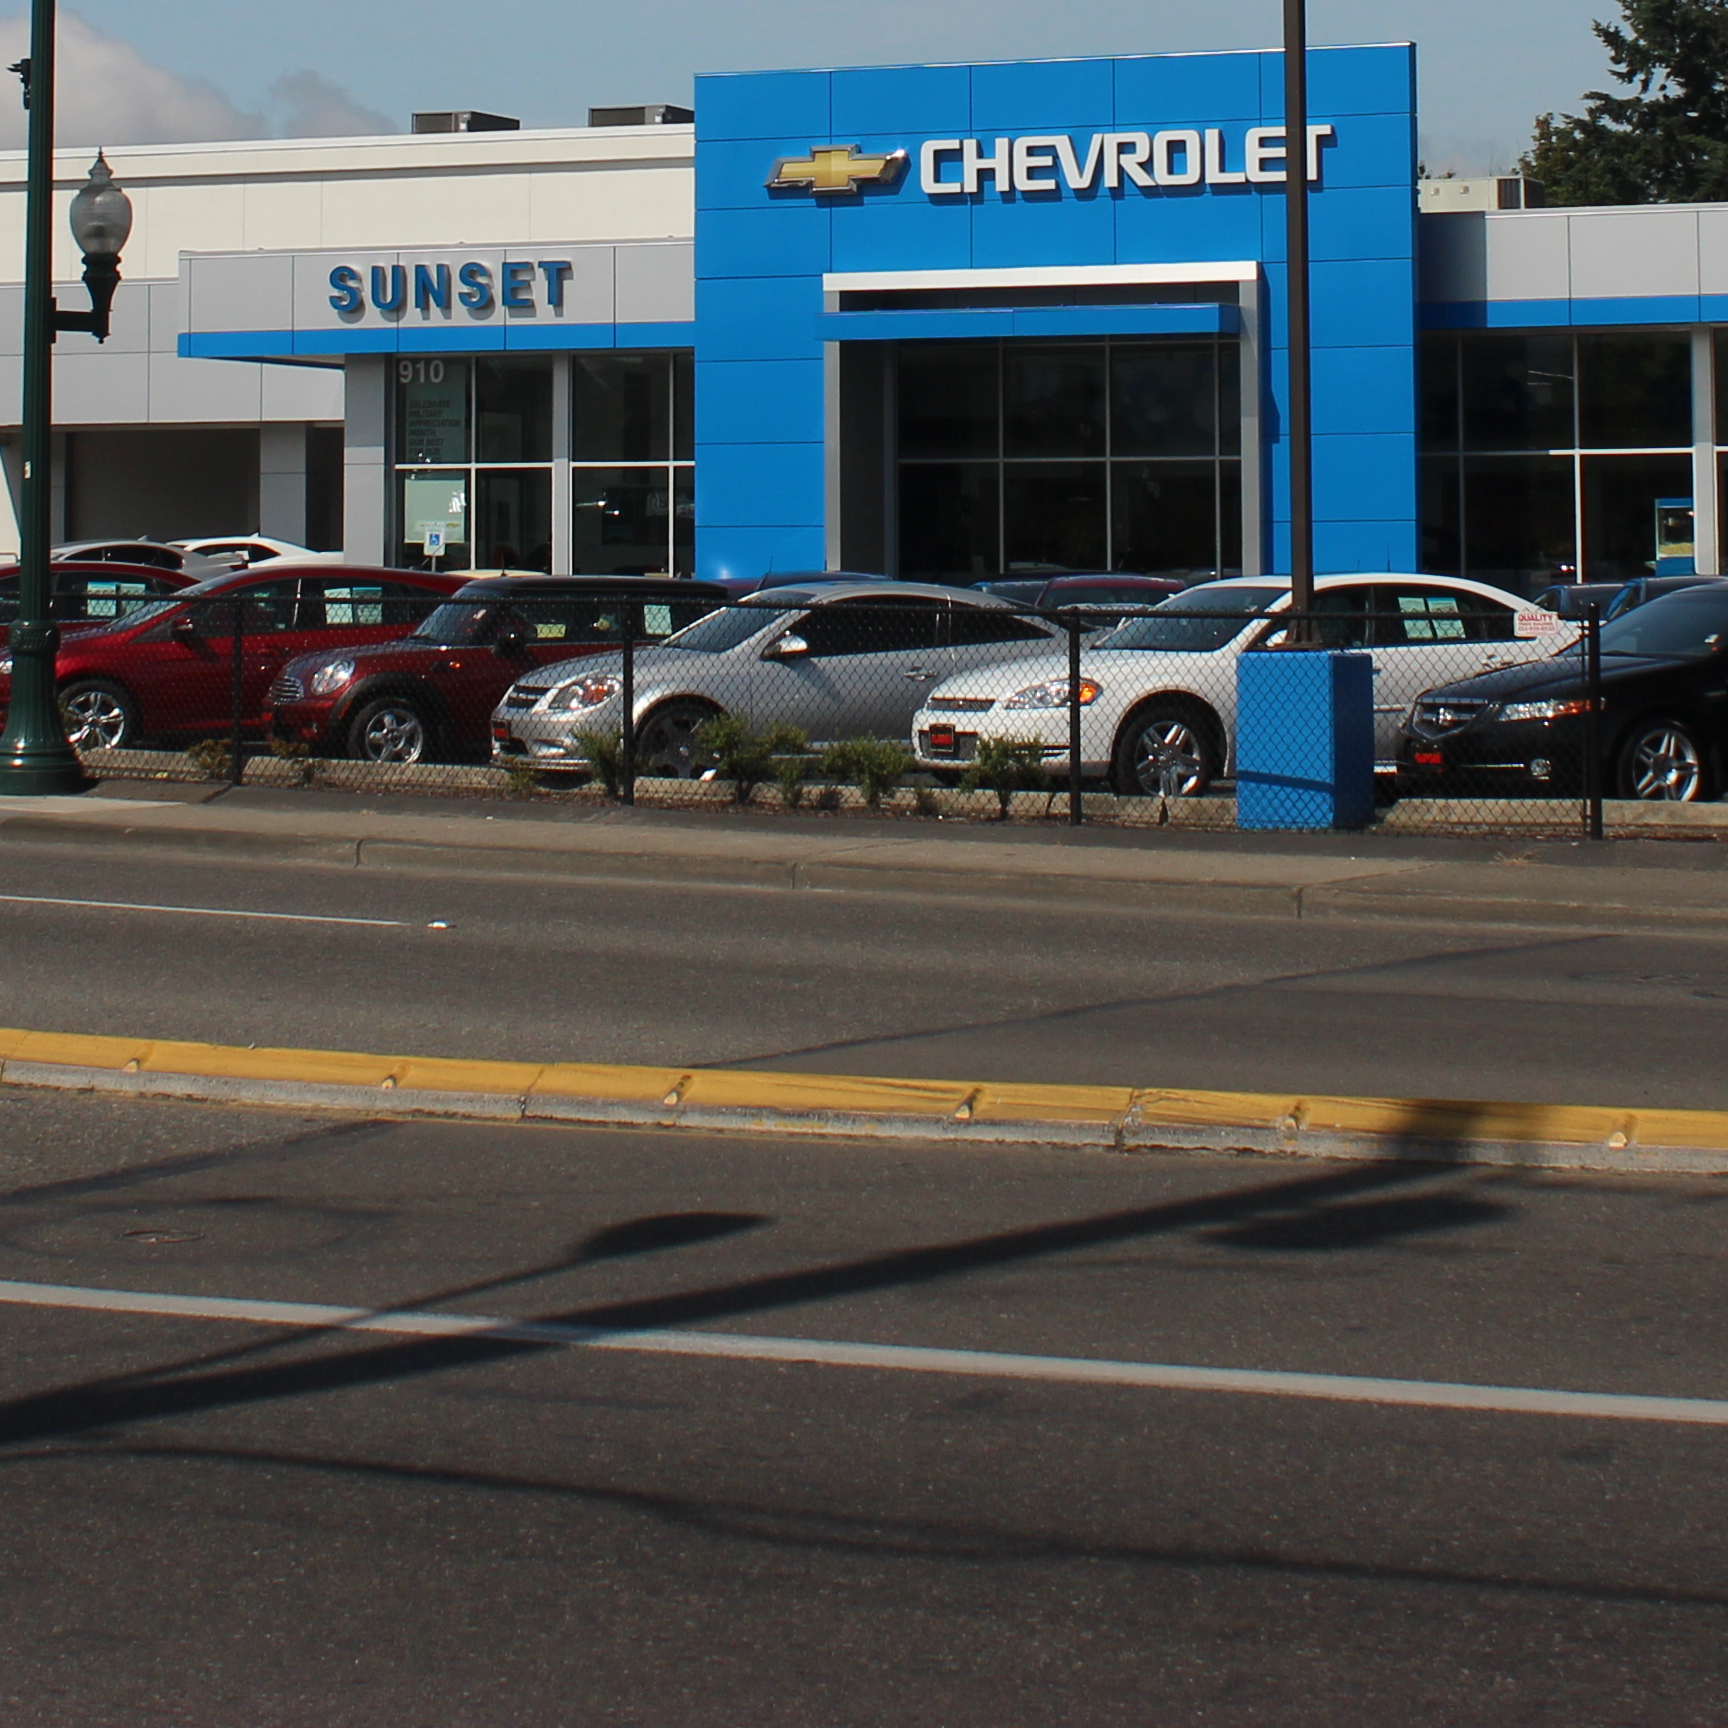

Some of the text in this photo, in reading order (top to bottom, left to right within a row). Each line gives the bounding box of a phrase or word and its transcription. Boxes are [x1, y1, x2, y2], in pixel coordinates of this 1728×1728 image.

[920, 124, 1333, 194] CHEVROLET
[329, 260, 572, 312] SUNSET
[399, 360, 444, 383] 910
[408, 399, 451, 408] CELEBRATE
[408, 410, 443, 418] MILITARY
[408, 419, 461, 427] APPRECIATION
[1518, 613, 1553, 622] QUALITY
